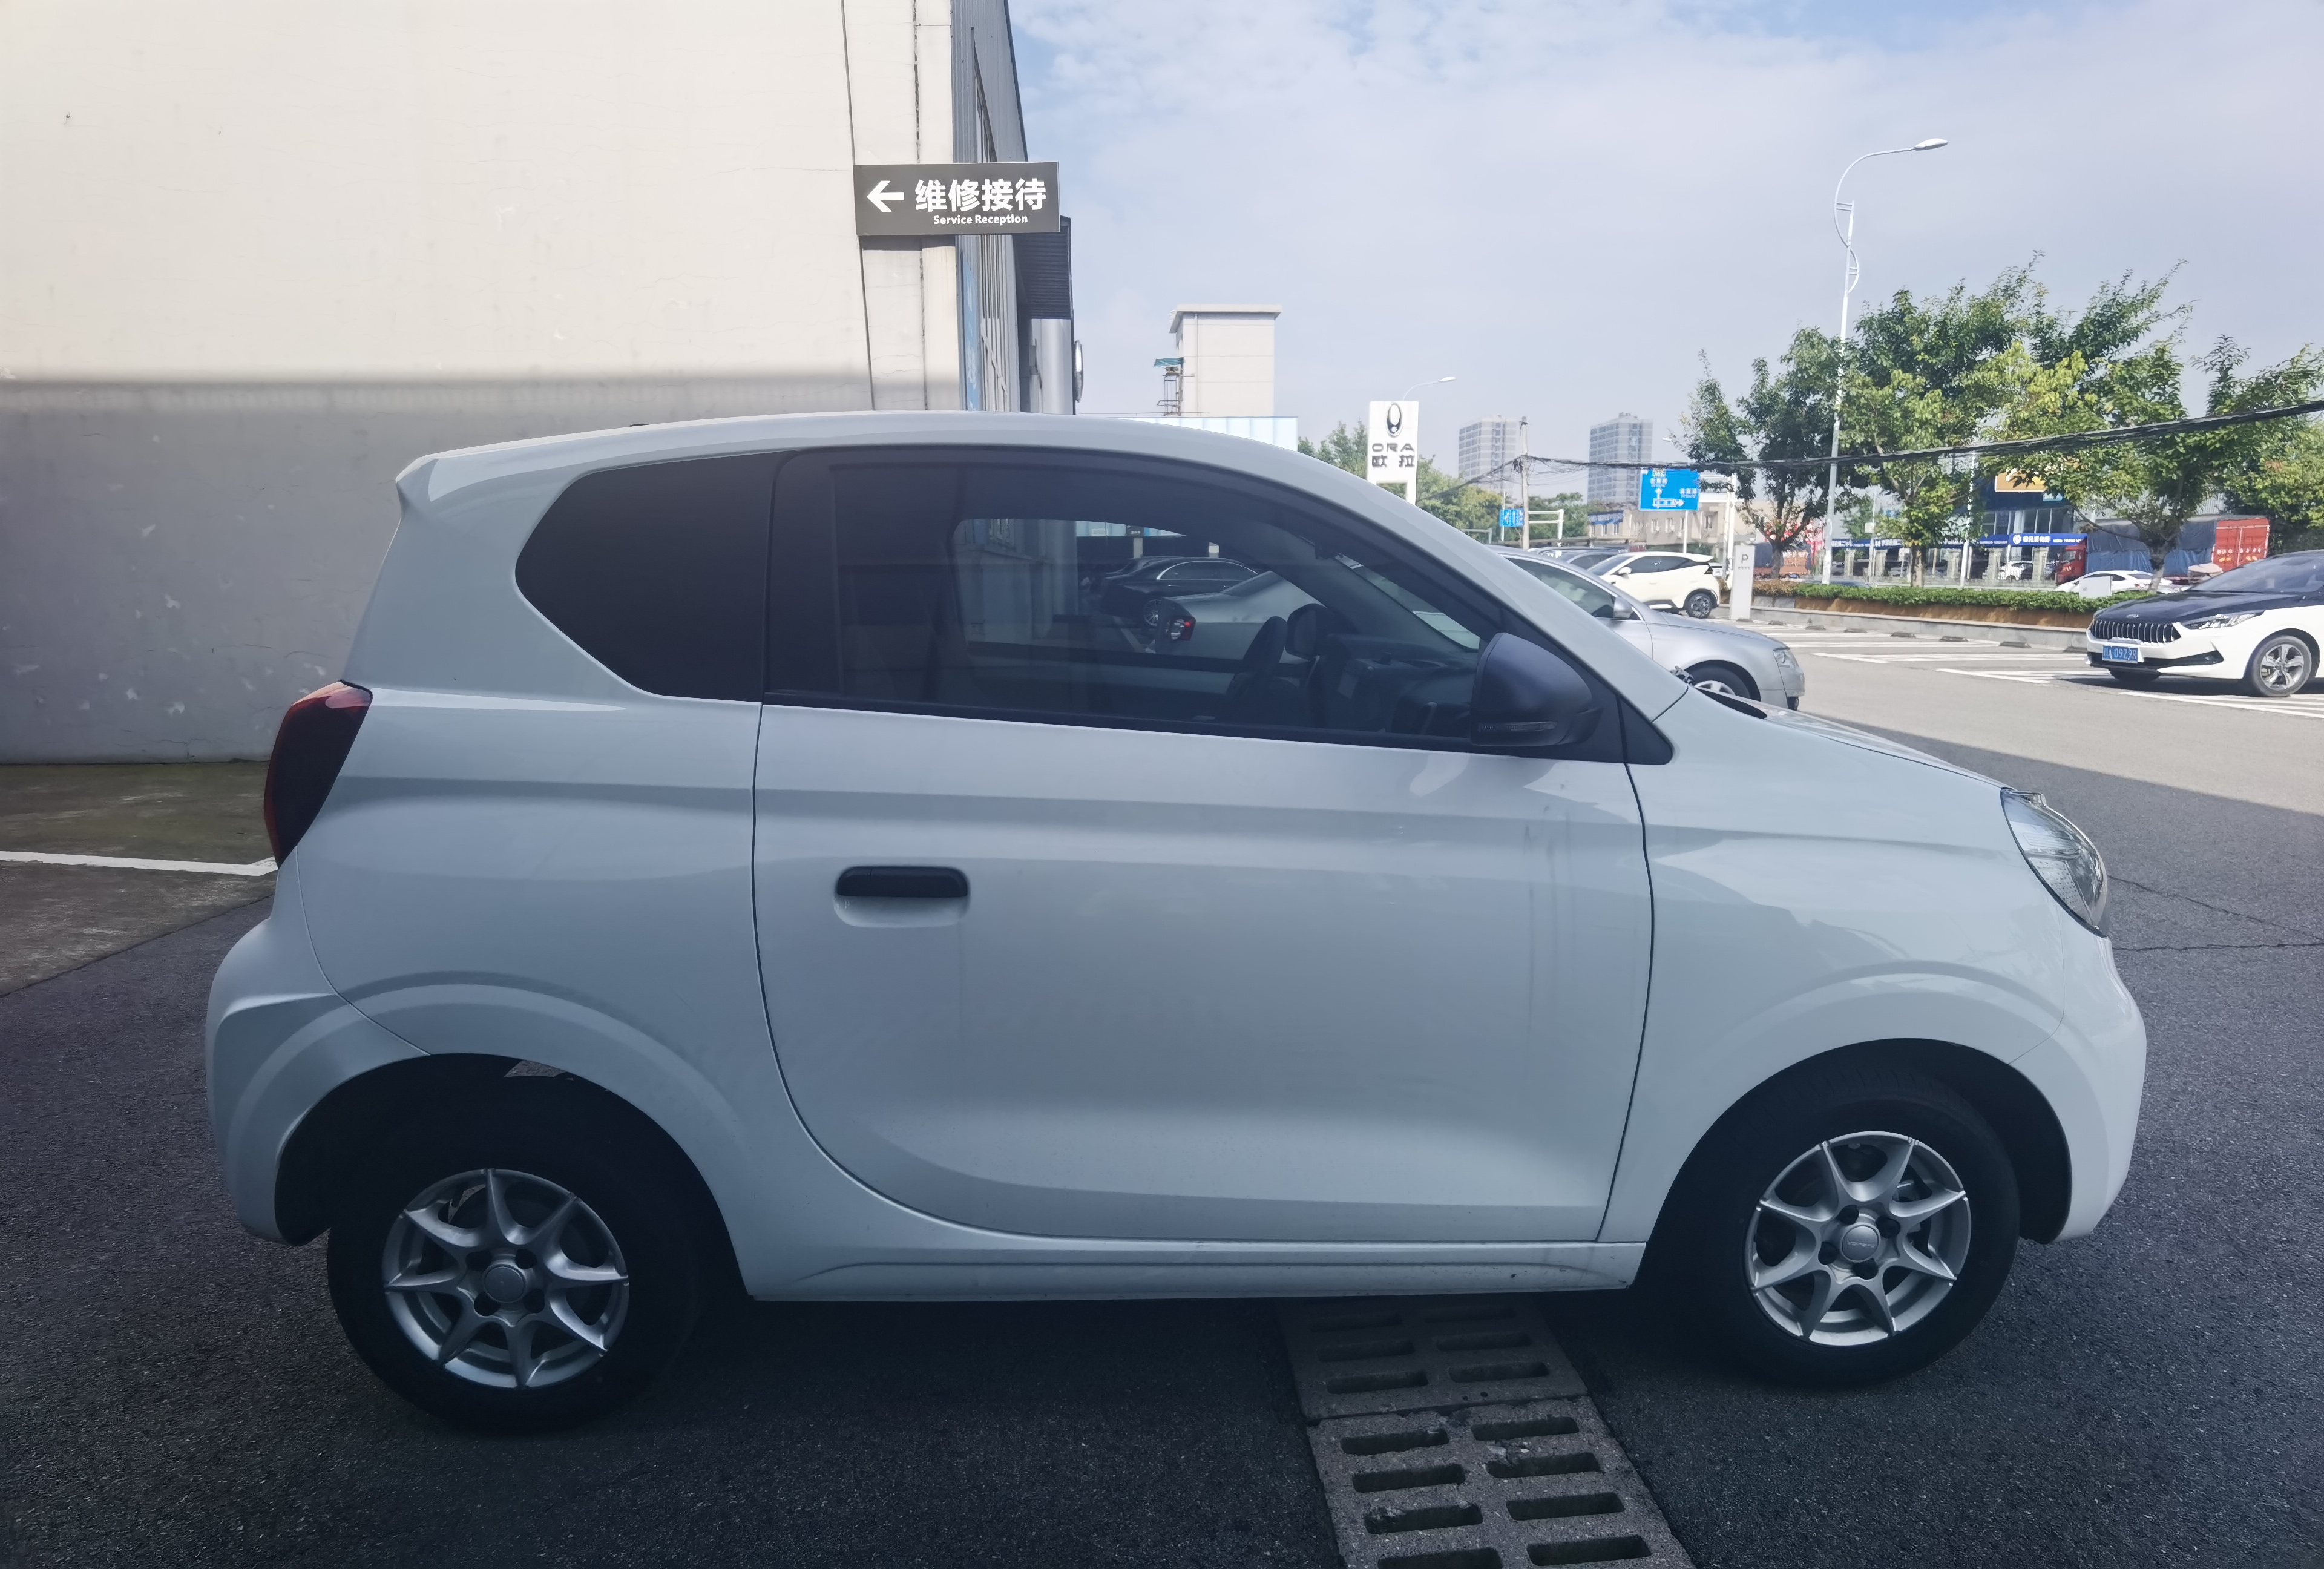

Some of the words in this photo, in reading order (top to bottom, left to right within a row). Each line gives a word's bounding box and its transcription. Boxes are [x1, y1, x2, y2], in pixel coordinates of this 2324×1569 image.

[914, 178, 1046, 212] 维修接待
[933, 215, 973, 225] Service
[975, 214, 1028, 226] Reception
[1372, 443, 1415, 452] ORA
[1371, 455, 1415, 468] 欧拉
[1741, 554, 1749, 564] P
